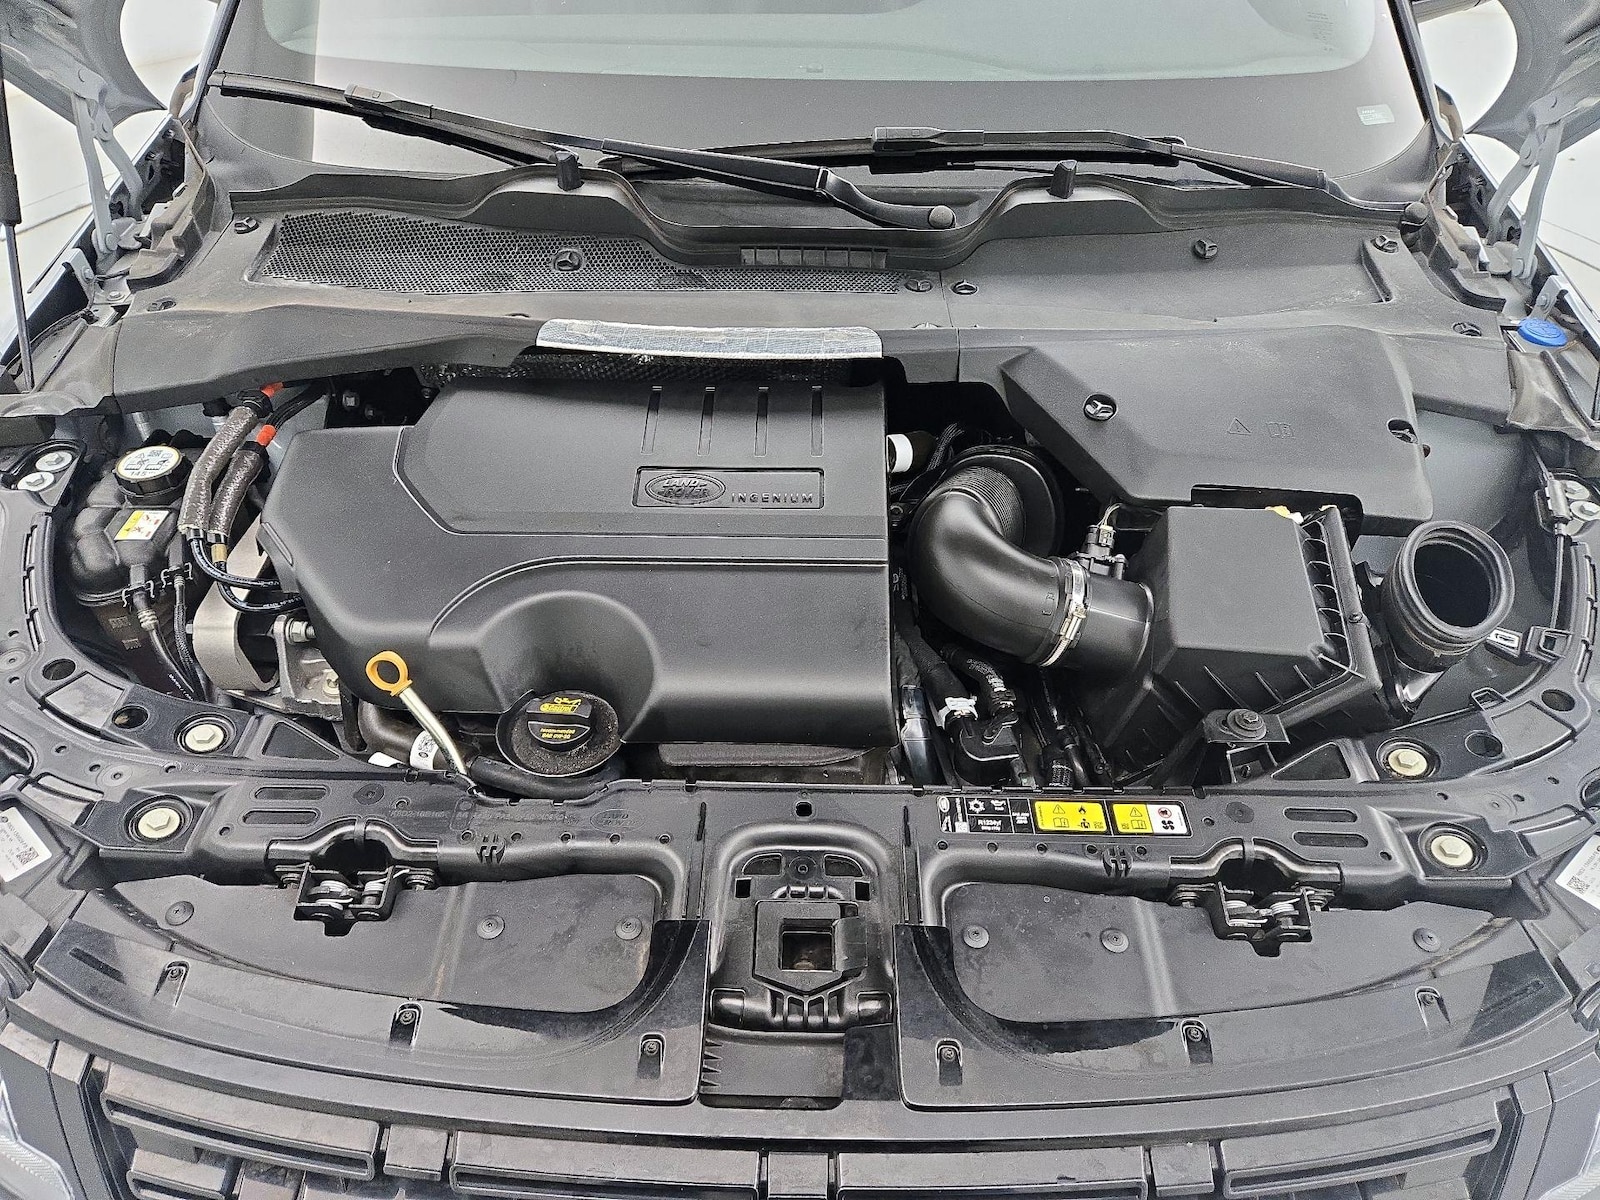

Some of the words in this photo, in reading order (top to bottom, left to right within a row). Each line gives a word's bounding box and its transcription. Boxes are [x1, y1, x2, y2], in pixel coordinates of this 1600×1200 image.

[662, 479, 700, 488] LAND
[664, 488, 711, 499] ROVER
[731, 492, 814, 504] INGENIUM
